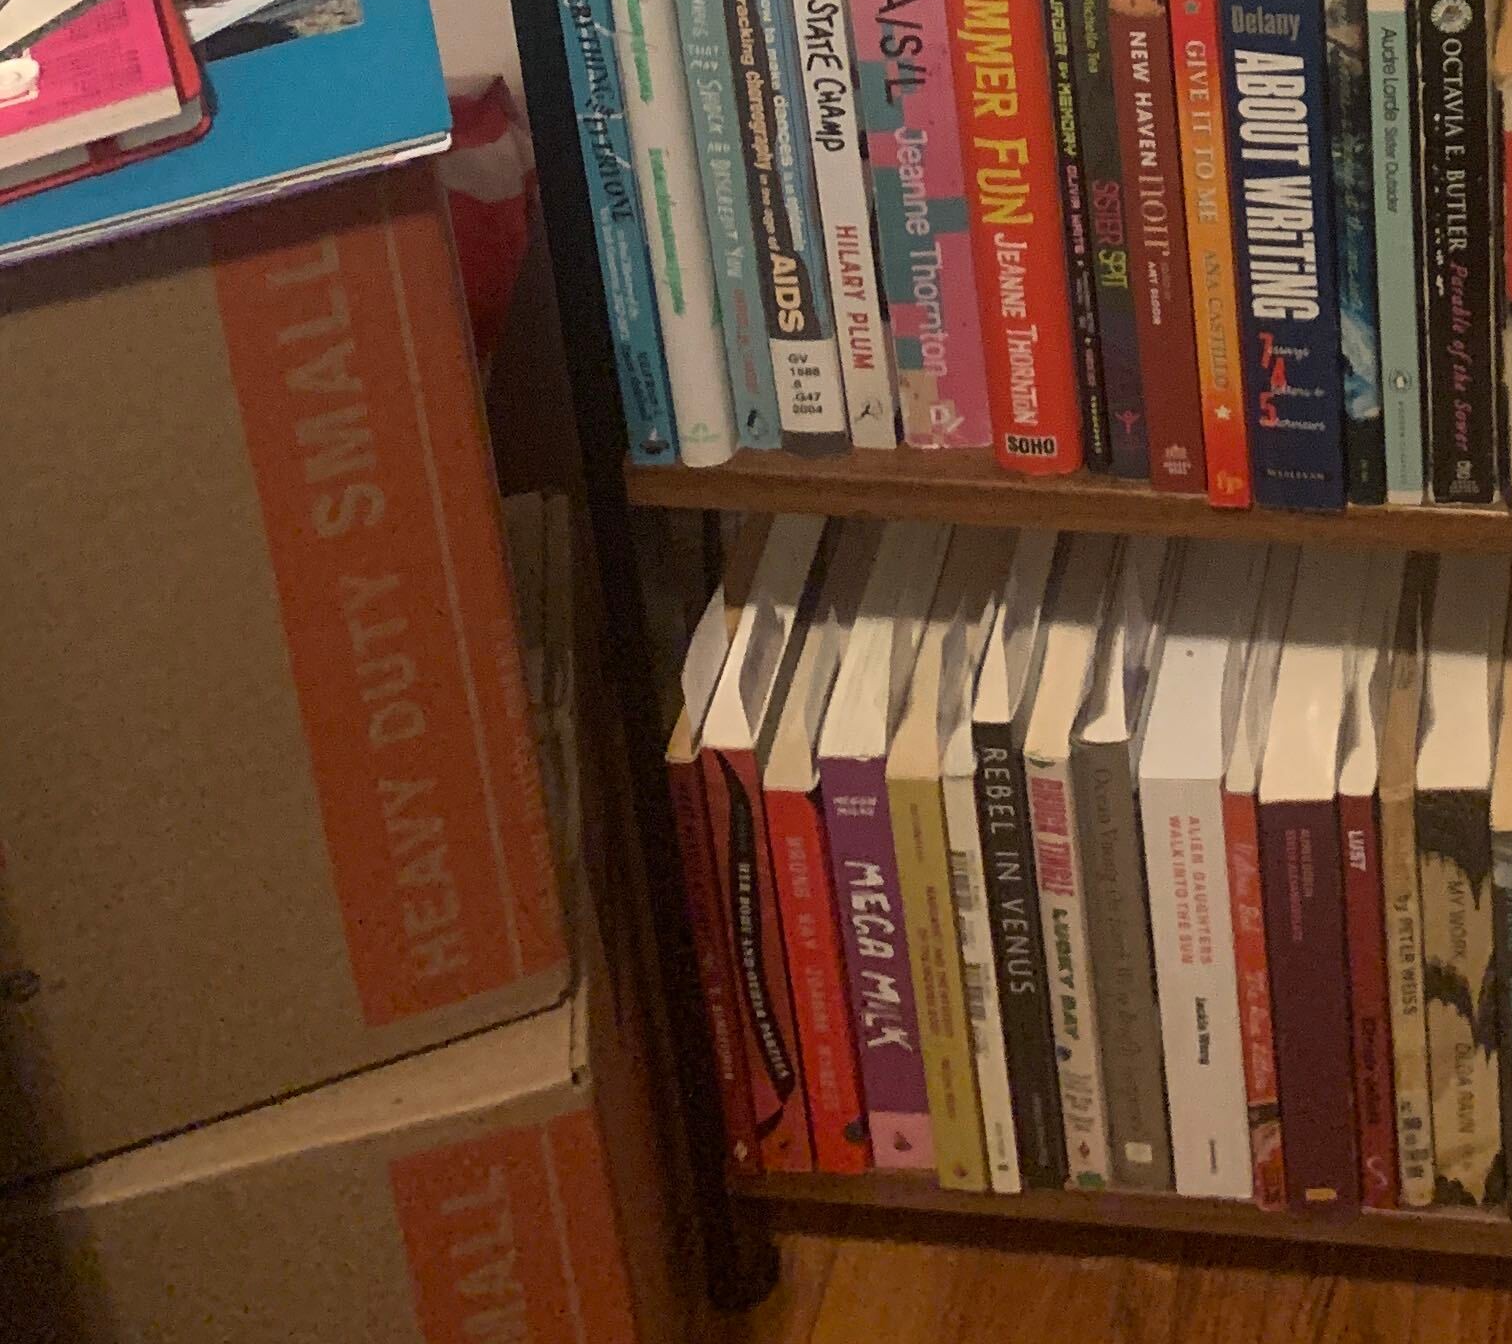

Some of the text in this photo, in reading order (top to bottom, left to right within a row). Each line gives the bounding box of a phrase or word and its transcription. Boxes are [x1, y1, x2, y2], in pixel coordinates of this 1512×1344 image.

[812, 74, 846, 153] CHAMP
[1128, 30, 1160, 170] NEW HAVEN
[973, 137, 1031, 228] FUN
[1232, 48, 1321, 322] ABOUT WRITING
[834, 224, 868, 303] HILARY
[843, 311, 874, 372] PLUM
[1006, 434, 1056, 456] SOHO
[263, 232, 475, 985] HEAVY DUTY SMALL
[979, 746, 1035, 996] REBEL IN VENUS
[844, 859, 915, 1054] MEGA MILK
